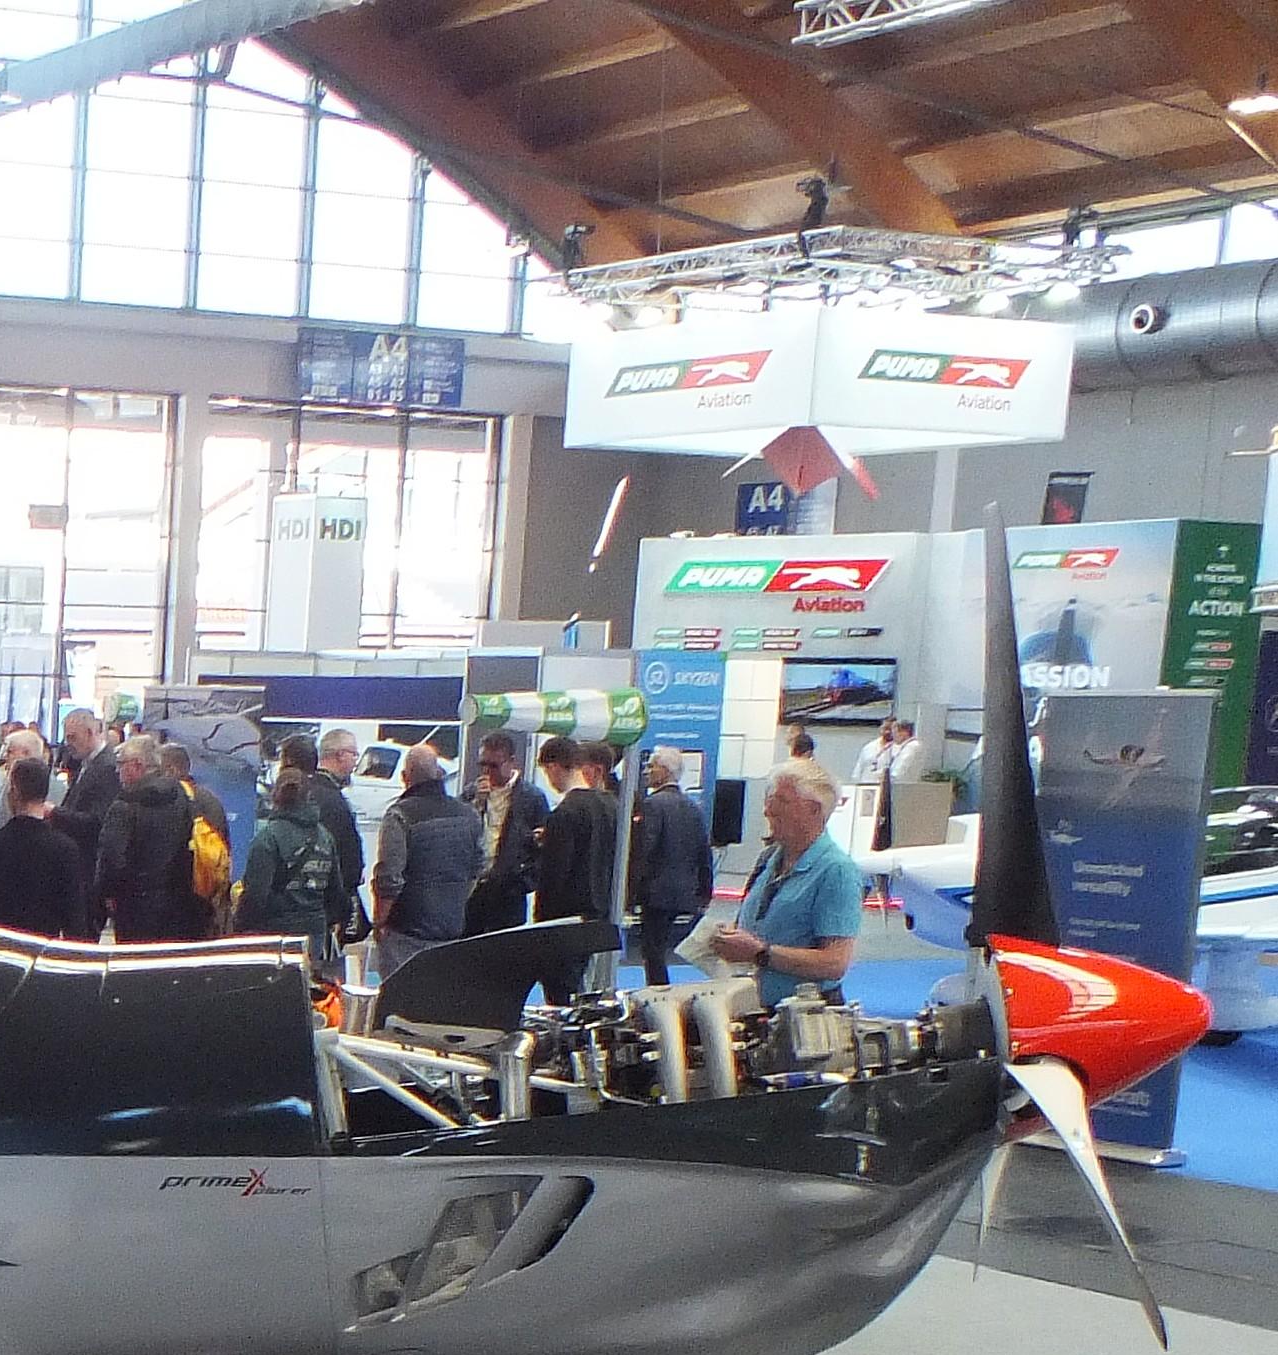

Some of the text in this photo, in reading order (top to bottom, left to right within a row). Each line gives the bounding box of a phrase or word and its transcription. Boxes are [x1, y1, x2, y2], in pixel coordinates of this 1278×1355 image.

[369, 335, 409, 362] A4
[869, 355, 939, 379] PUMA
[615, 366, 680, 392] PUMA
[697, 392, 752, 409] Aviation
[957, 393, 1012, 412] Aviation
[747, 484, 784, 514] A4
[277, 518, 310, 541] HDI
[319, 518, 362, 541] HDI
[677, 566, 766, 587] PUMA
[793, 598, 866, 613] Aviation
[1188, 600, 1244, 617] ACTION
